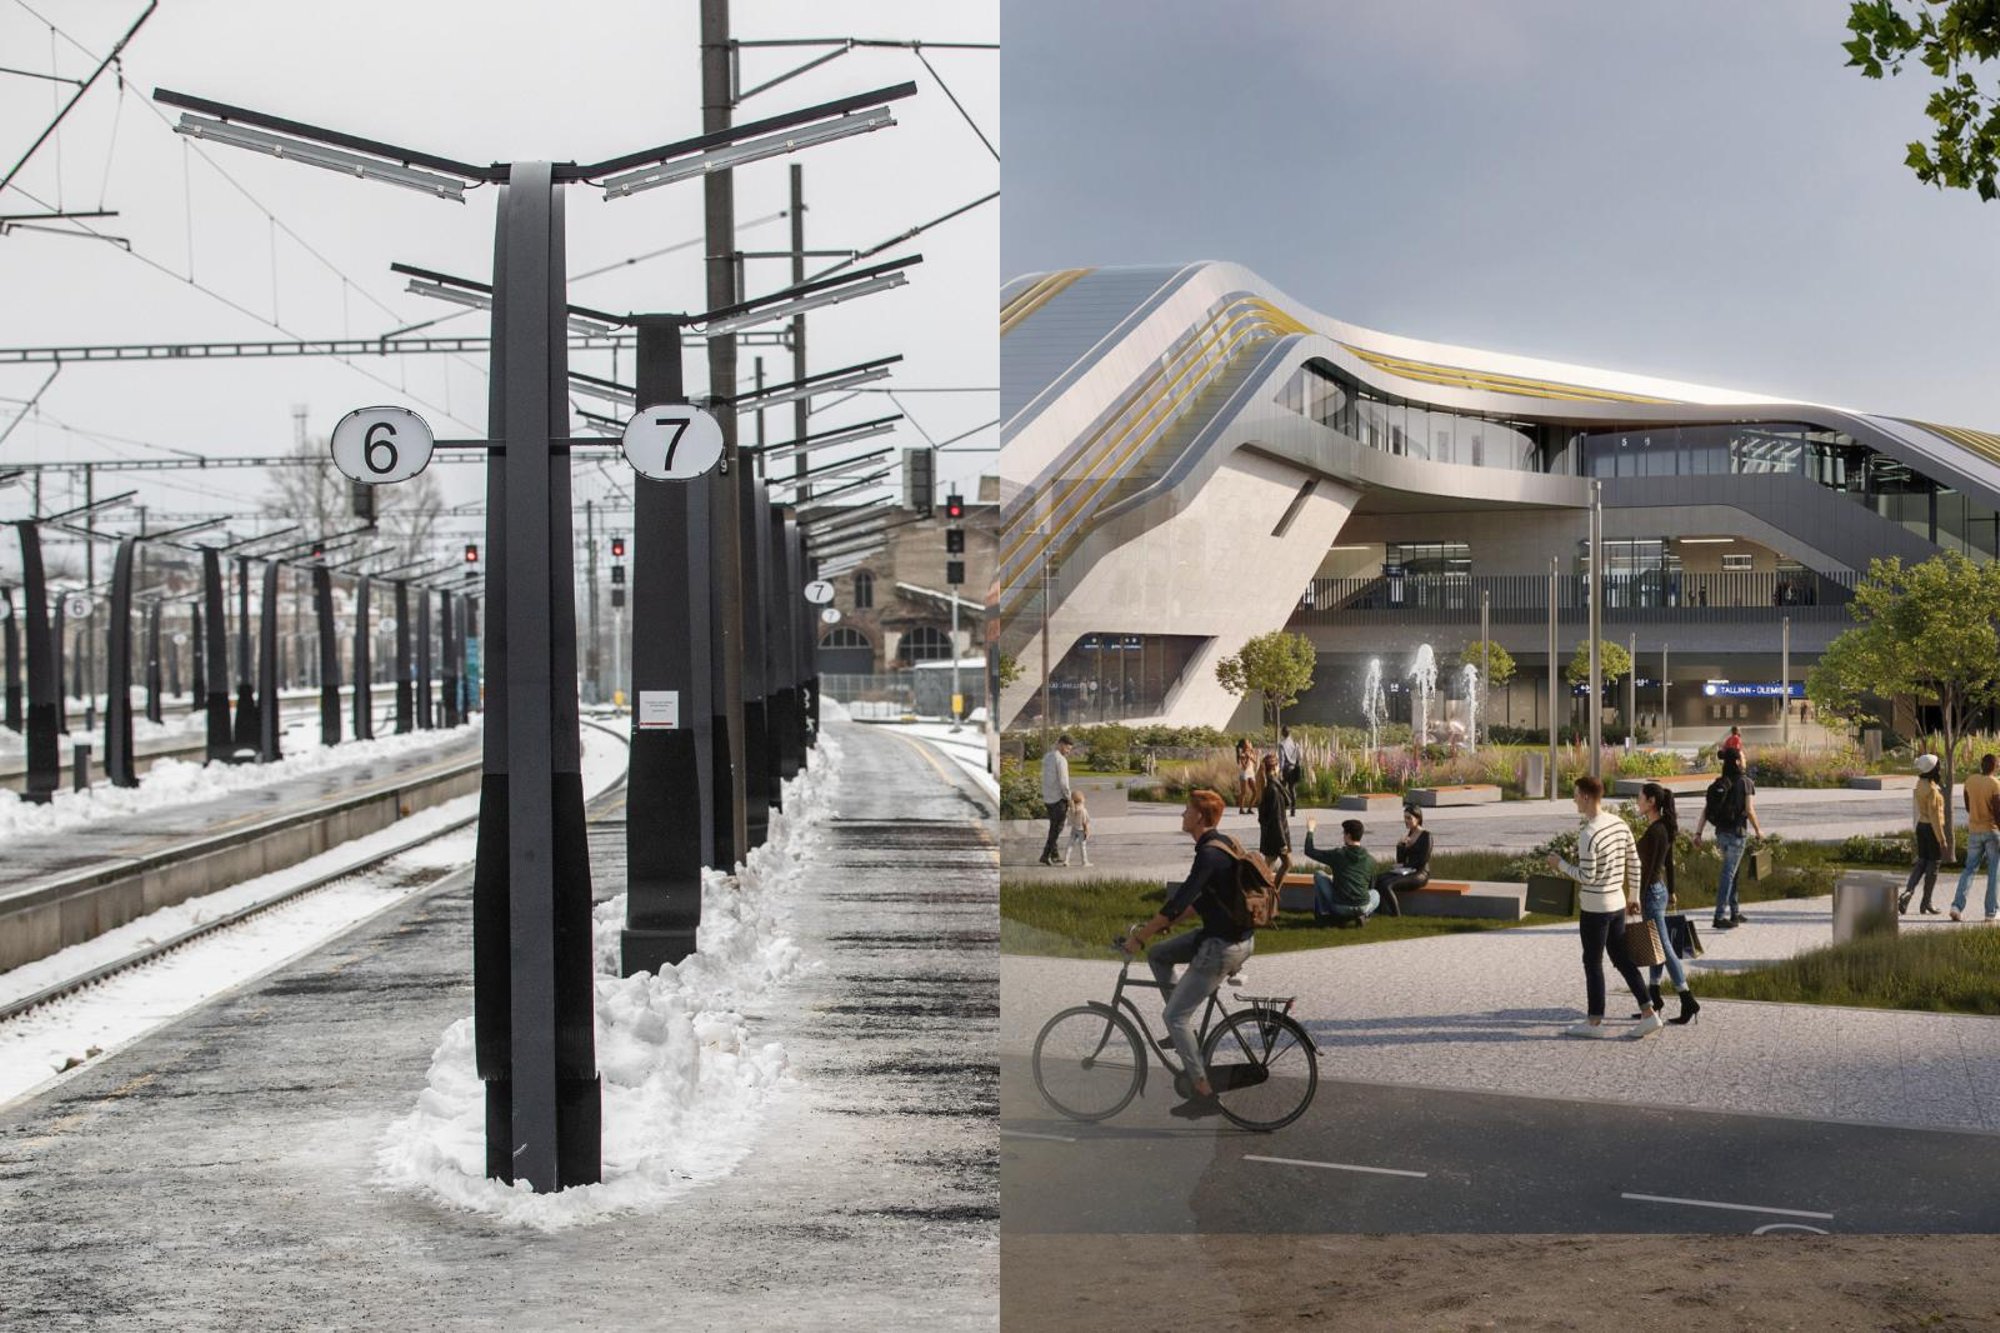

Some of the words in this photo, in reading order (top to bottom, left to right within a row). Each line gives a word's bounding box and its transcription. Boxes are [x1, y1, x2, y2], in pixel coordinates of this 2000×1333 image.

[364, 422, 398, 474] 6
[656, 418, 690, 471] 7
[814, 584, 824, 600] 7
